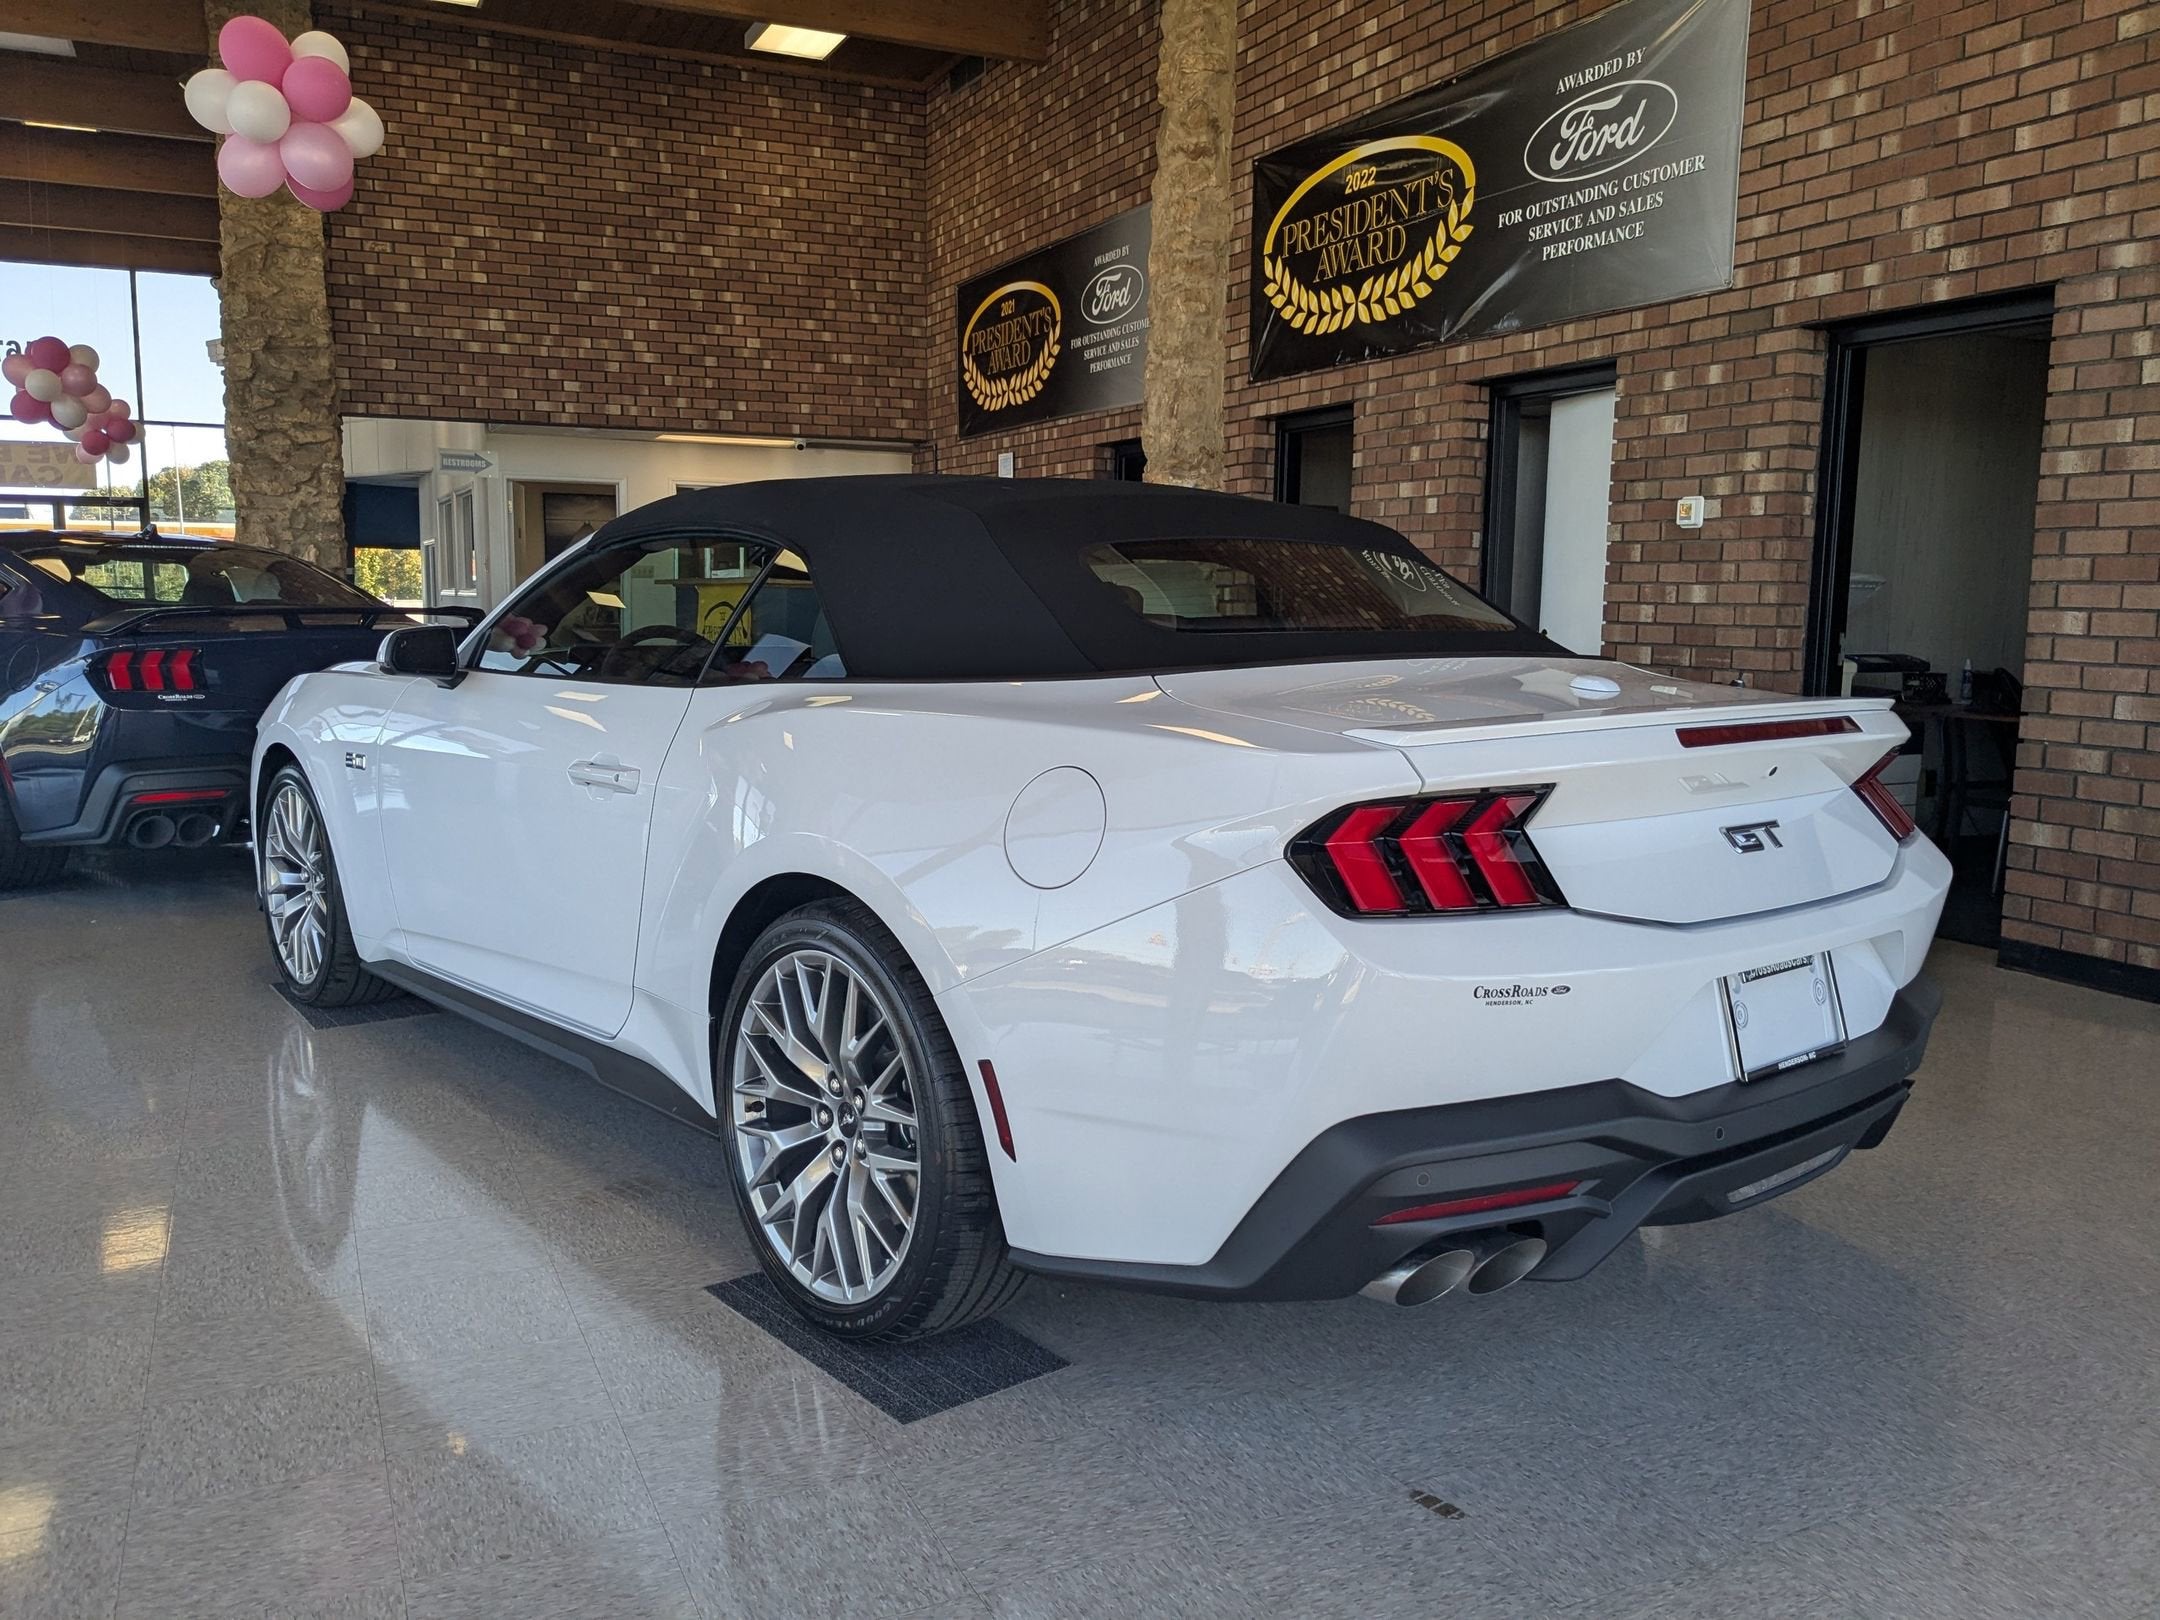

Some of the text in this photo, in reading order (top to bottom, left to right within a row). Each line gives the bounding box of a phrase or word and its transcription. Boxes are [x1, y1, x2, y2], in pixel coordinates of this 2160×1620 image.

[1555, 47, 1647, 95] AWARDED BY
[1549, 94, 1648, 170] Ford
[1344, 166, 1377, 195] 2022
[1497, 154, 1706, 229] FOR OUTSTANDING CUSTOMER
[1282, 168, 1454, 258] PRESIDENT'S
[1528, 191, 1664, 242] SERVICE AND SALES
[1093, 245, 1130, 268] AWARDED BY
[1313, 224, 1406, 284] AWARD
[1541, 221, 1645, 261] PERFORMANCE
[1001, 298, 1015, 317] 2021
[1092, 272, 1131, 316] Ford
[971, 306, 1052, 356] PRESIDENT'S
[1070, 318, 1150, 350] FOR OUTSTANDING CUSTOME
[1083, 335, 1140, 361] SERVICE AND SALES
[987, 340, 1031, 376] AWARD
[1089, 353, 1132, 374] PERFORMANCE
[1719, 819, 1783, 855] GT
